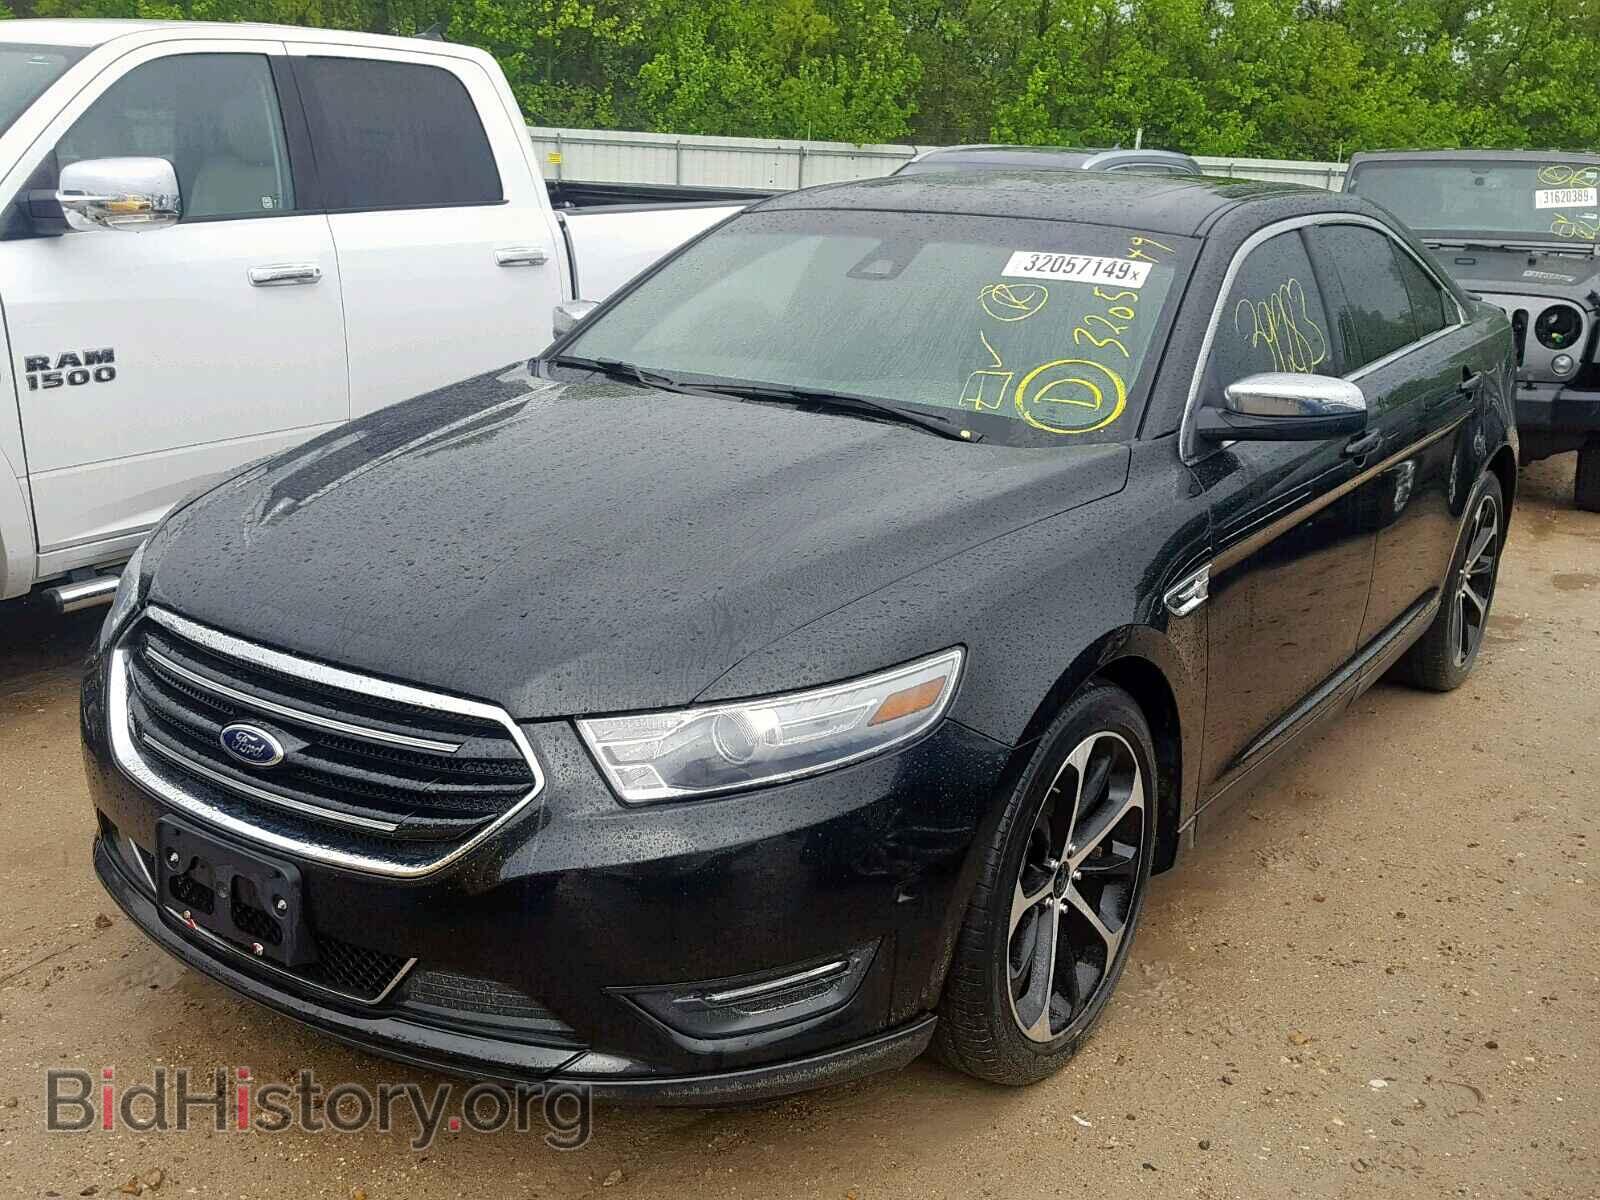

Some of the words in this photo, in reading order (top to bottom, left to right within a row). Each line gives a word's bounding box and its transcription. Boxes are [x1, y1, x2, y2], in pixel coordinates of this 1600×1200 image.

[24, 348, 116, 373] RAM
[25, 366, 117, 391] 1500
[231, 731, 266, 758] Ford
